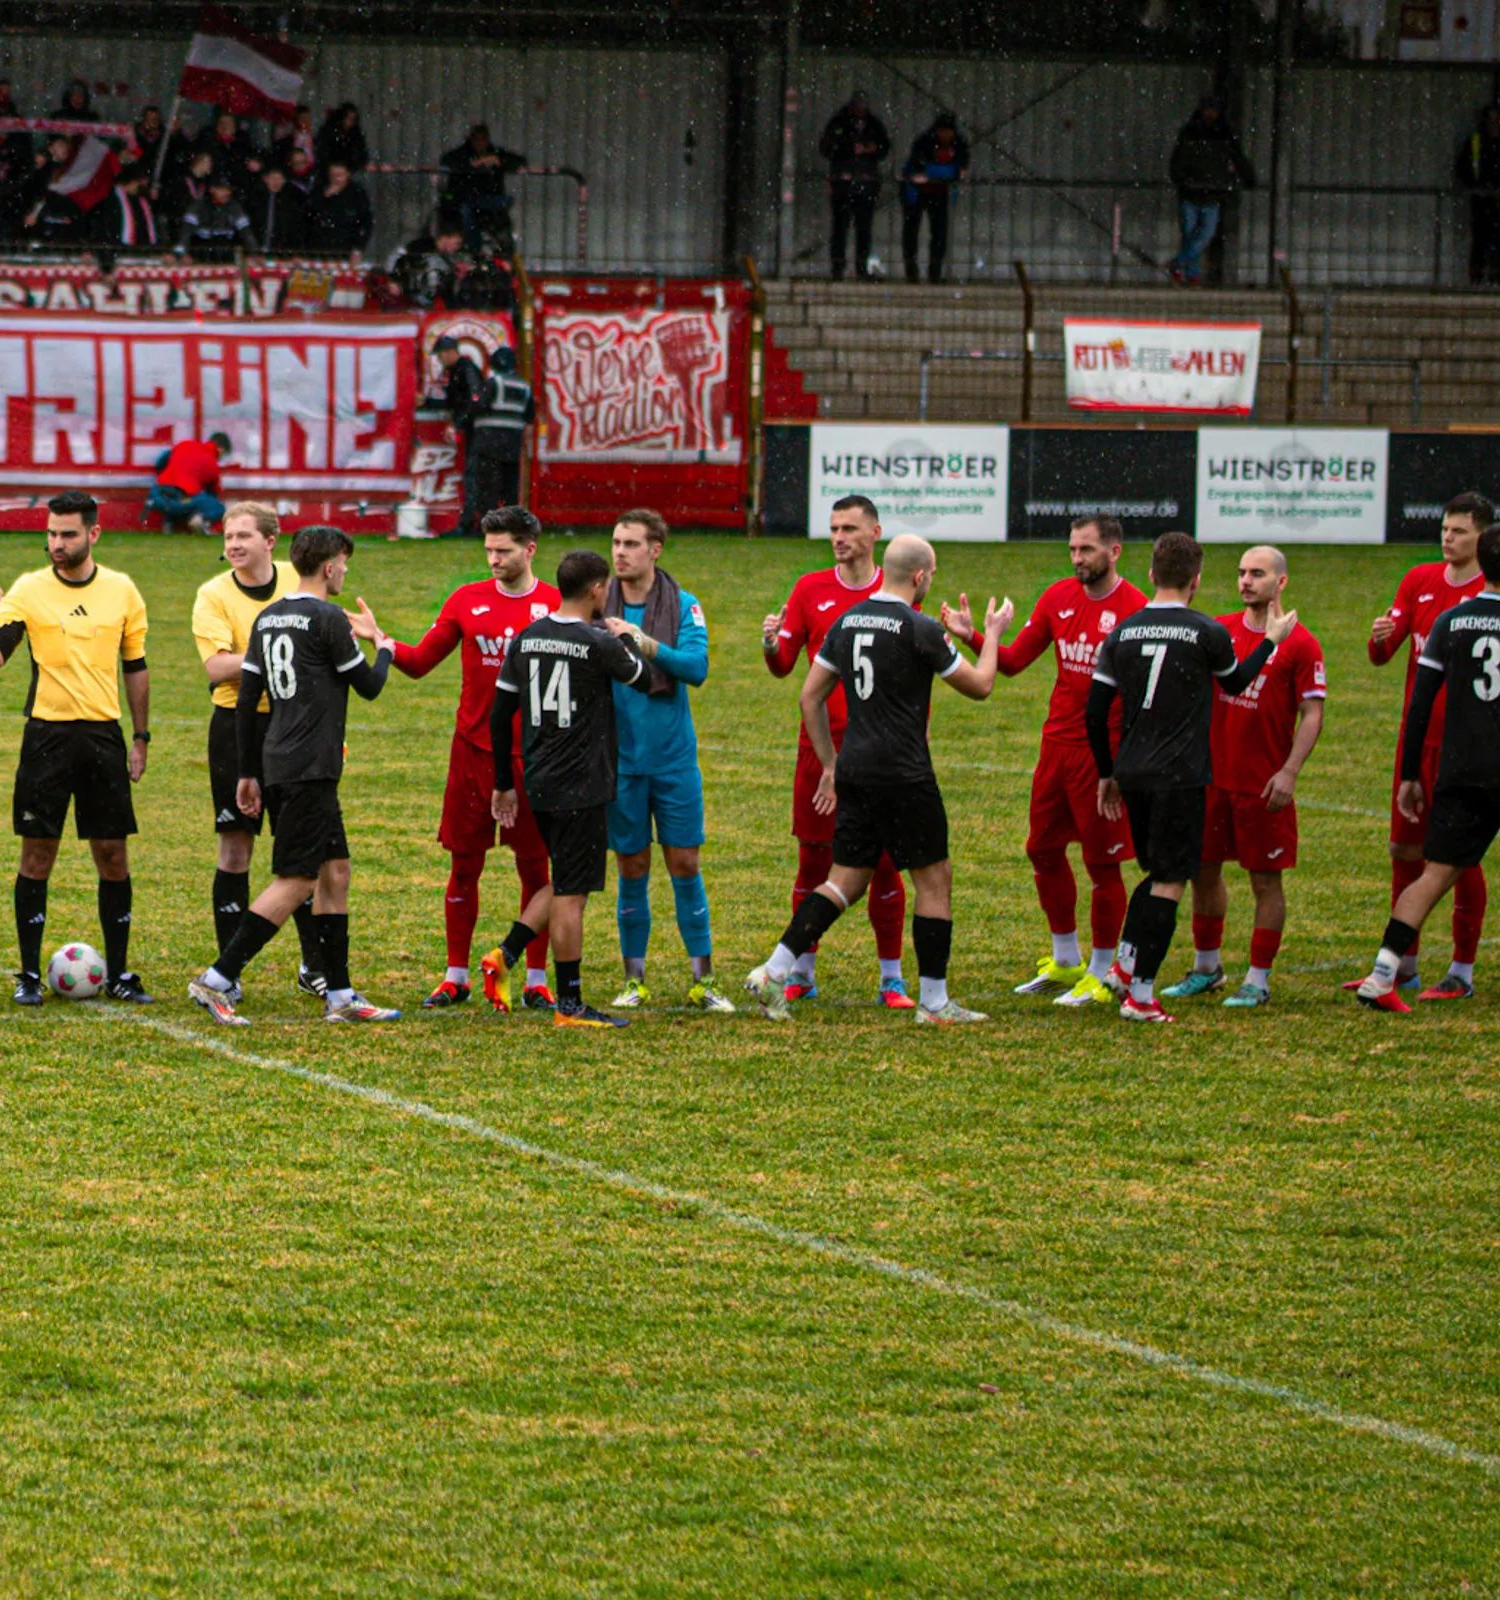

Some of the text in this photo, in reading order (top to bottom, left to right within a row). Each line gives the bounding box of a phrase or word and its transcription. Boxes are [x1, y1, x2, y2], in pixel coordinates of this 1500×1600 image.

[821, 455, 997, 479] WIENSTRÖER
[1208, 457, 1376, 481] WIENSTRÖER
[262, 633, 297, 700] 18
[853, 633, 875, 701] 5
[1119, 625, 1199, 645] ERKENSCHWICK
[529, 658, 577, 728] 14
[1141, 643, 1167, 710] 7
[1471, 636, 1500, 702] 3
